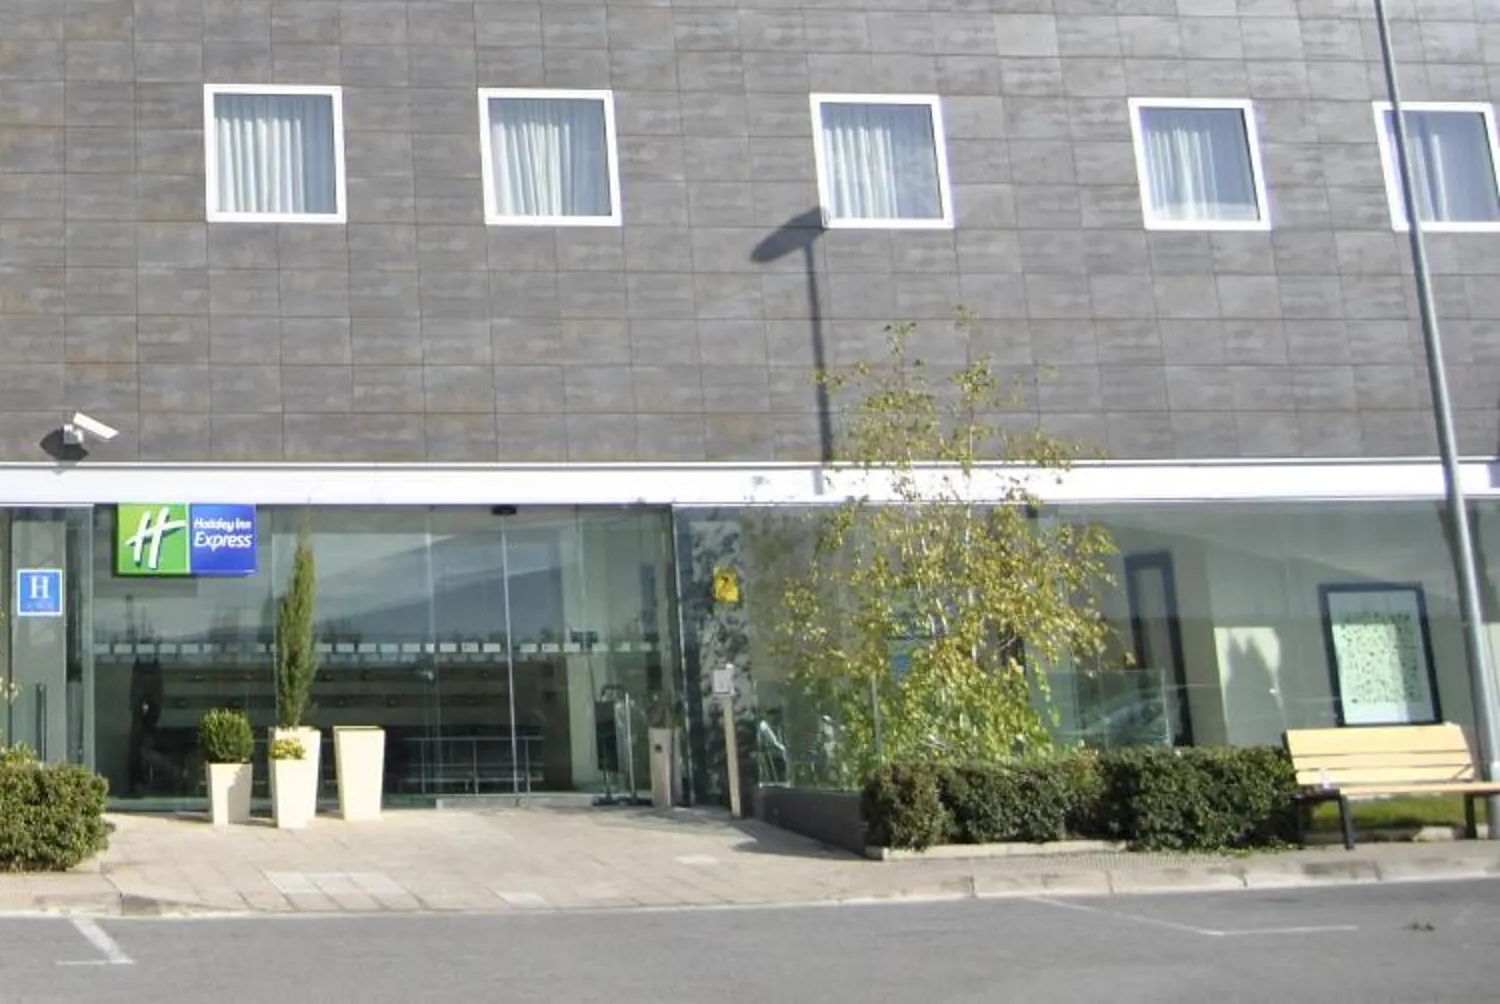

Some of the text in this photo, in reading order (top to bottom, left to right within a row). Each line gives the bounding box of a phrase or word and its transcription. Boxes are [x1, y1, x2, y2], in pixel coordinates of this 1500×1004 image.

[193, 516, 252, 533] Holiday Inn
[193, 531, 252, 552] Express
[31, 576, 49, 598] H
